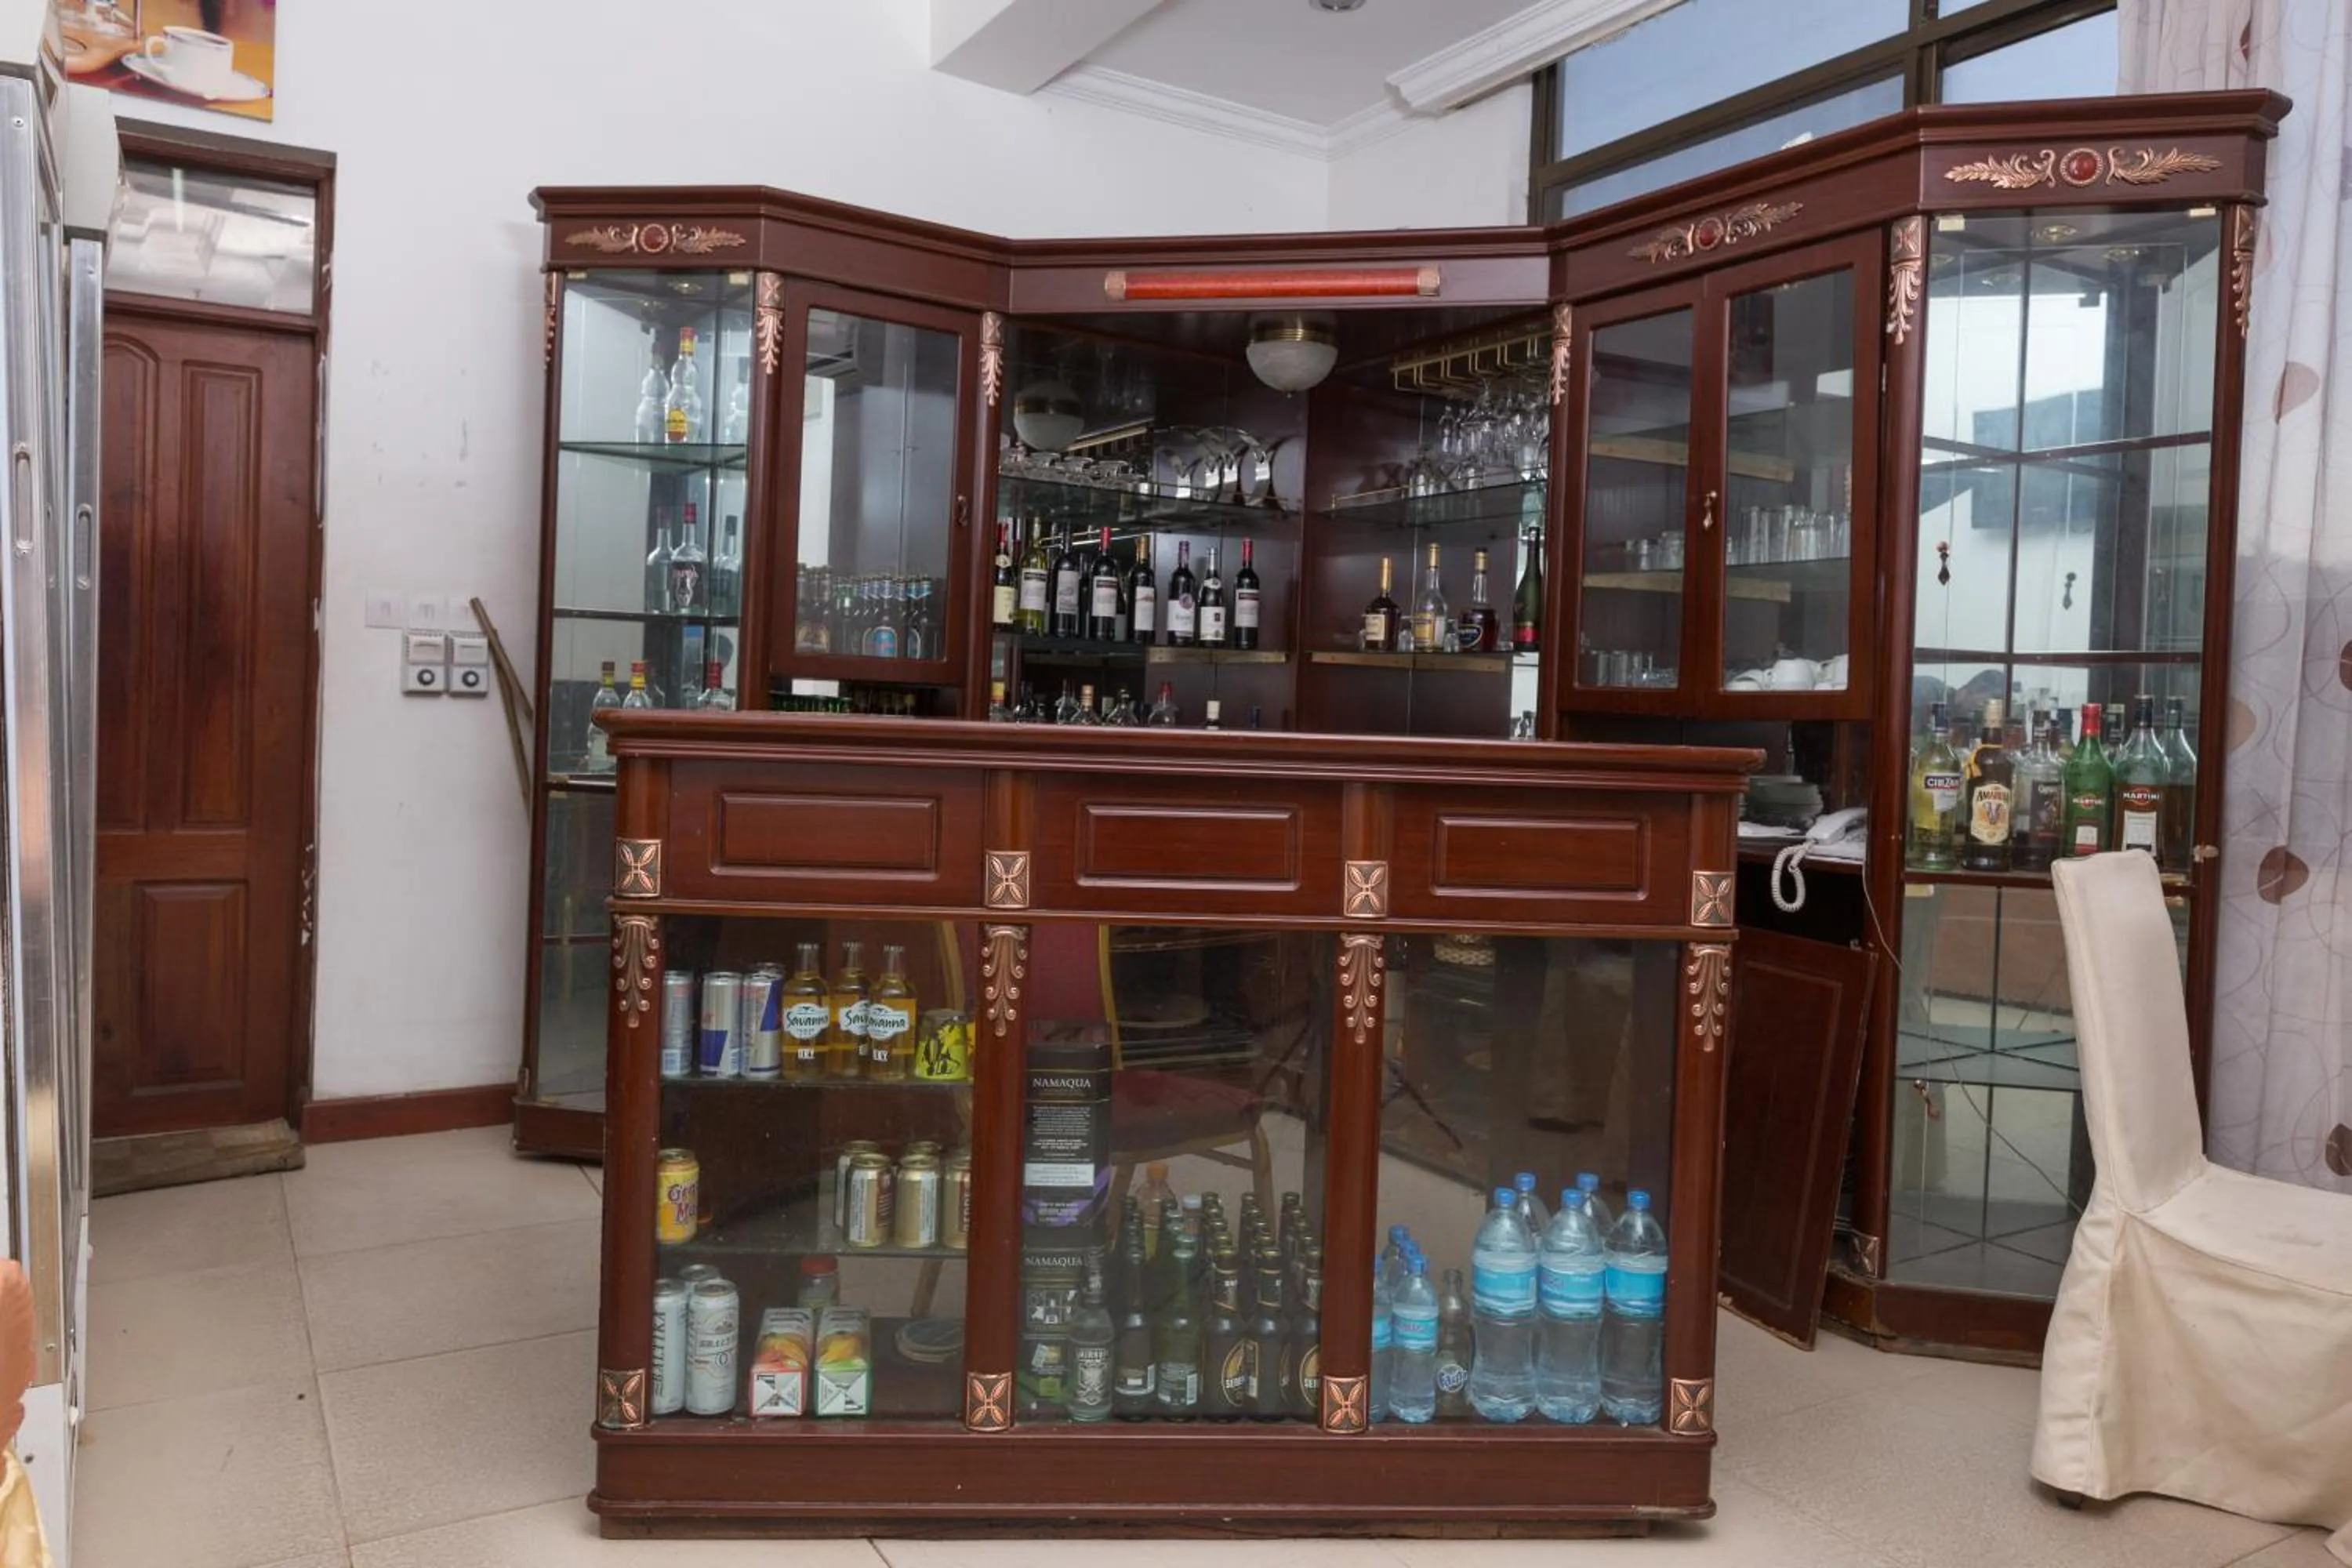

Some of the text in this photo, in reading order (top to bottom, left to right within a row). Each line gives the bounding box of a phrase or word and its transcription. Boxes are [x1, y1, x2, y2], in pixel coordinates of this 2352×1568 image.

[2072, 797, 2105, 805] MARTINI
[2122, 791, 2161, 800] MARTINI
[786, 1009, 829, 1029] Savanna
[1033, 1077, 1091, 1090] NAMAQUA
[1025, 1255, 1083, 1268] NAMAQUA
